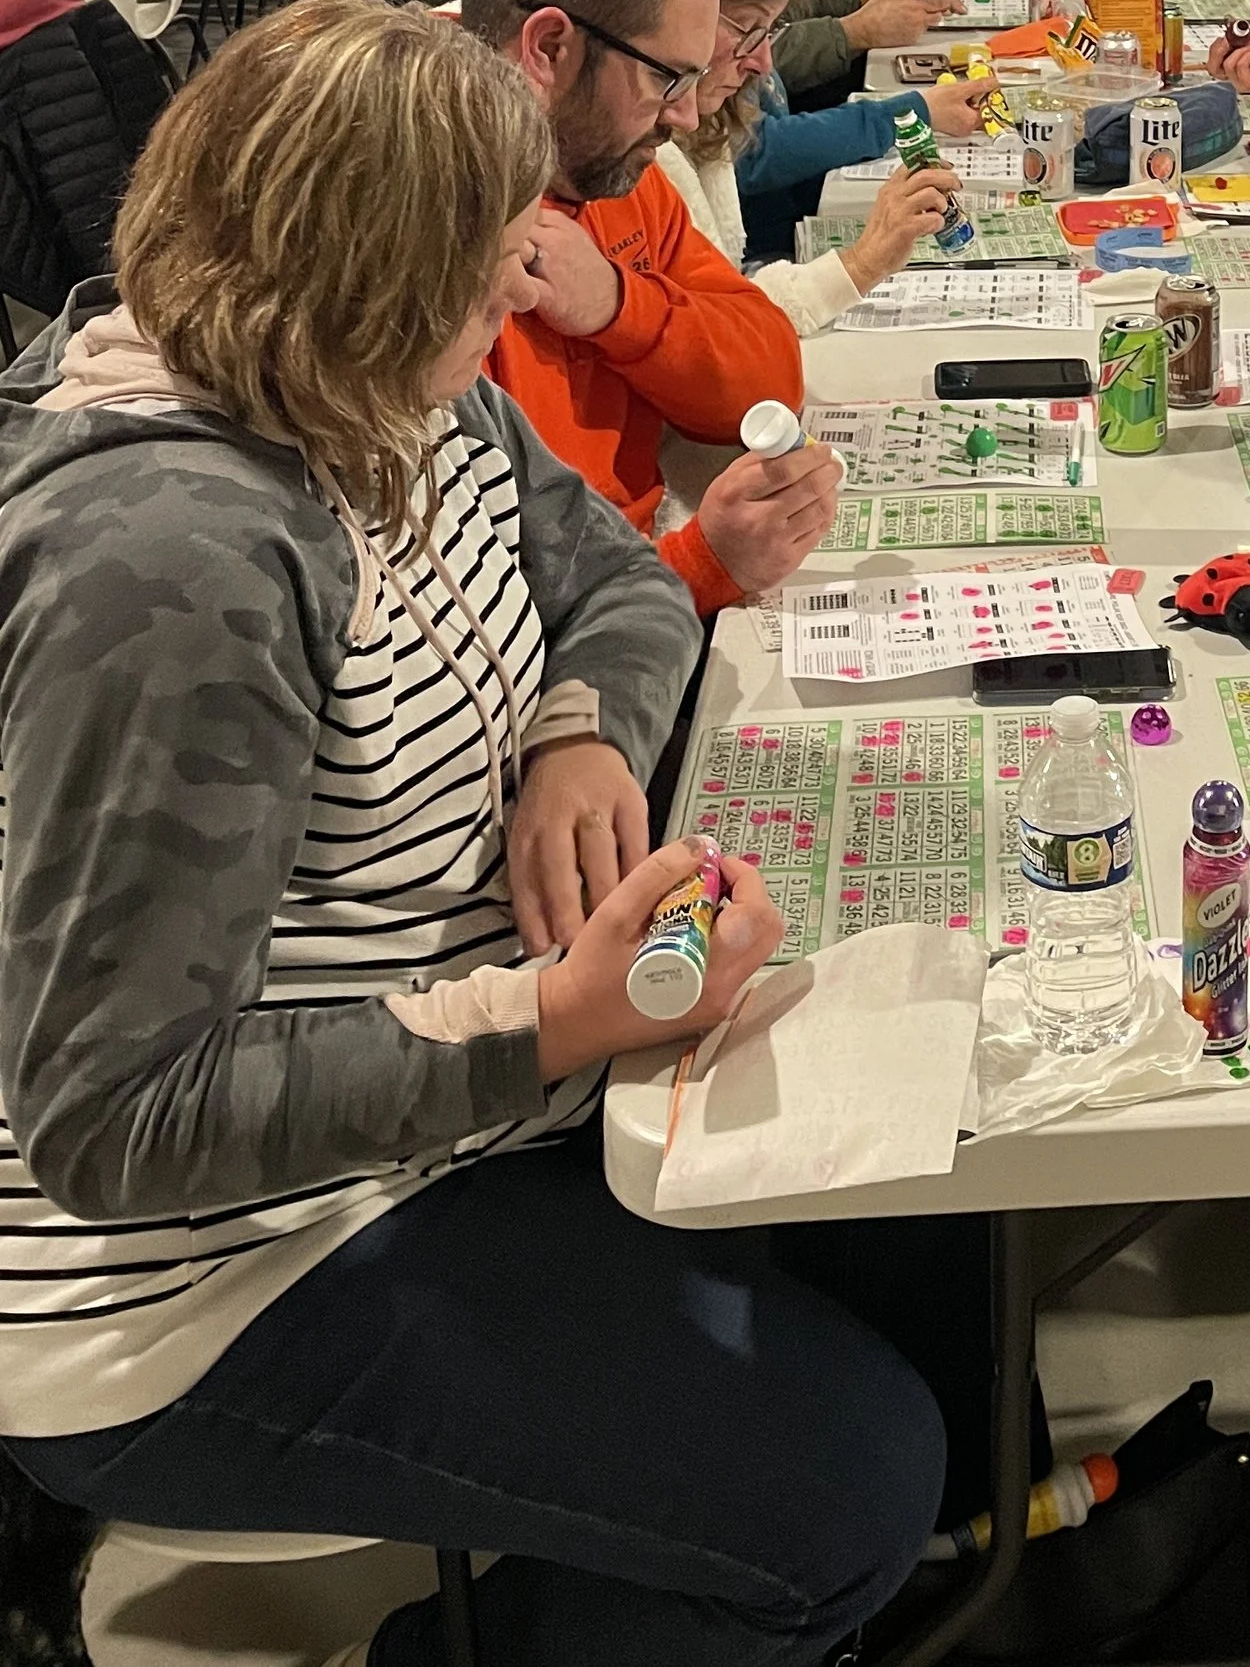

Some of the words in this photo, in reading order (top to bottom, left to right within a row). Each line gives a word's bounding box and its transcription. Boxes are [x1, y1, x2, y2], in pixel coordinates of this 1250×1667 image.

[1141, 118, 1180, 146] Lite
[927, 819, 943, 830] 45
[926, 833, 942, 844] 57
[926, 848, 942, 860] 70
[1203, 888, 1237, 921] VIOLET
[1193, 917, 1249, 993] Dazzle
